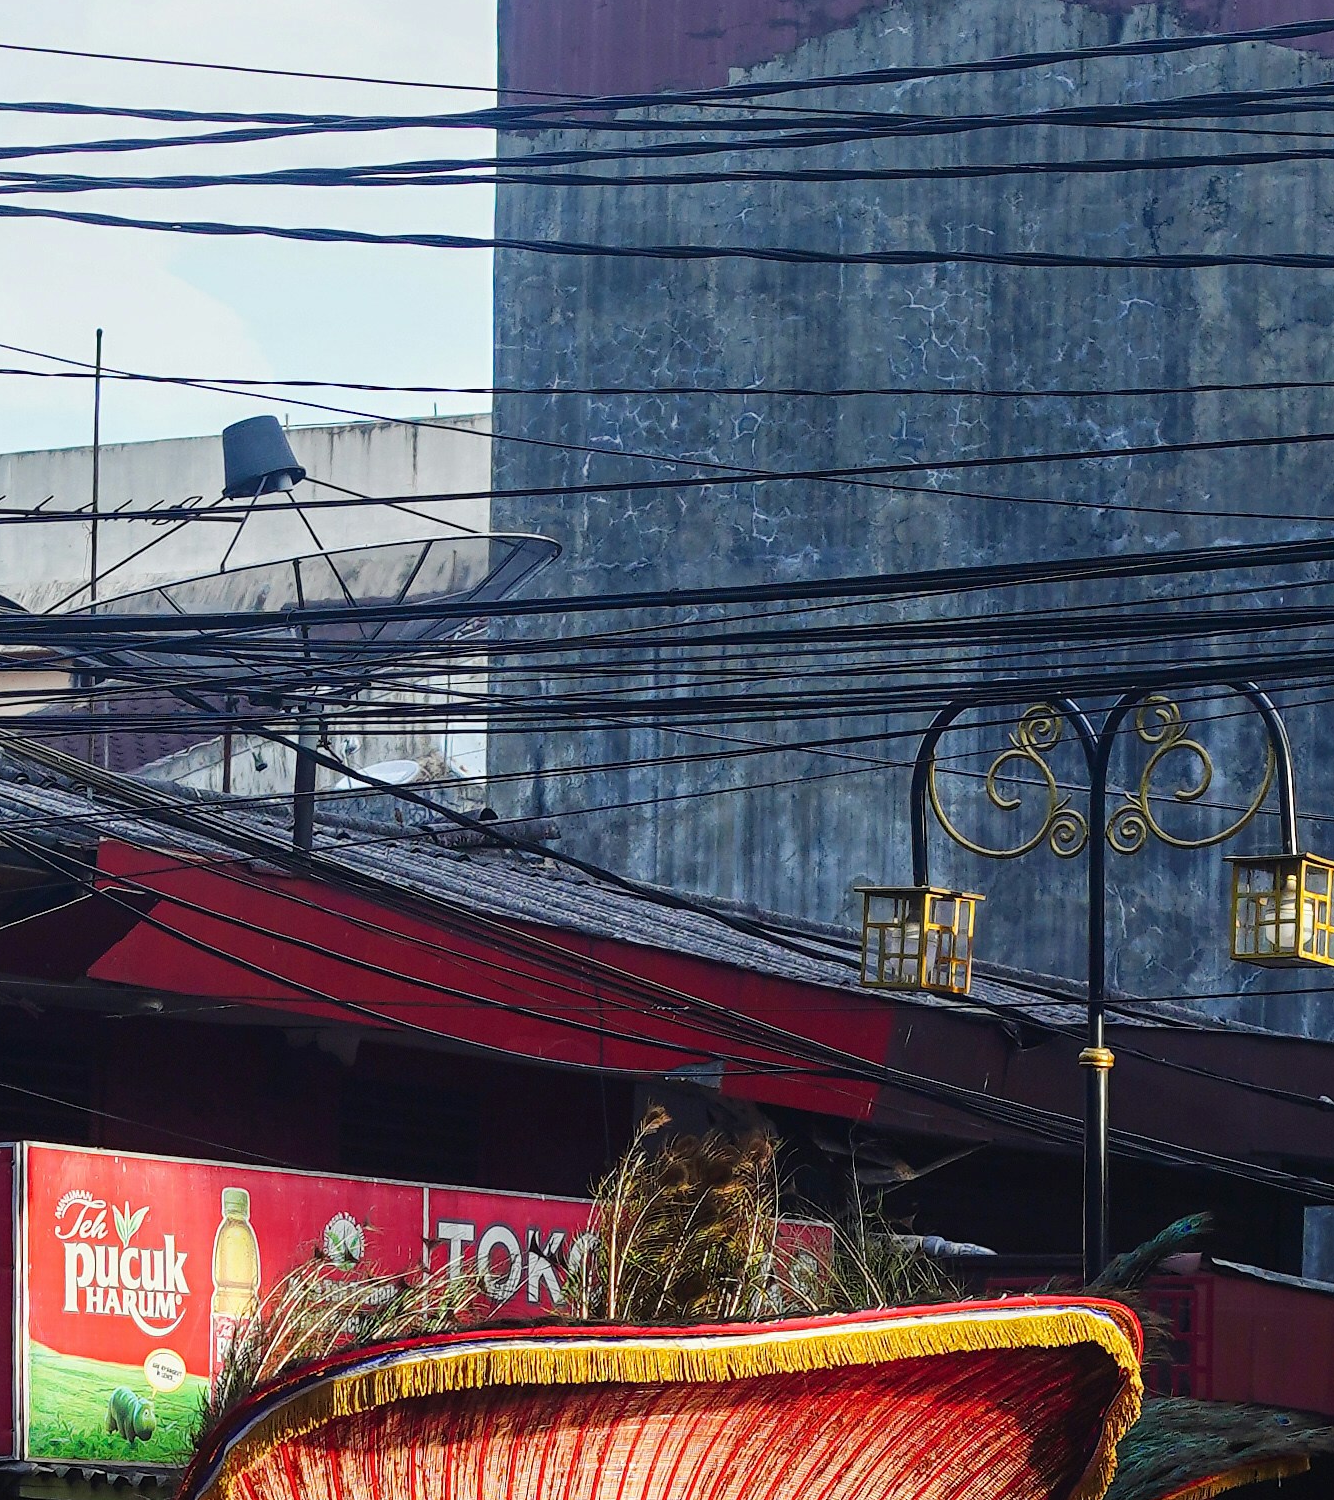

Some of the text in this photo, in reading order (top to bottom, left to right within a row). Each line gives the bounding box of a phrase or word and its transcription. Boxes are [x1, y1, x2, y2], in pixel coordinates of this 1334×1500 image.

[55, 1199, 109, 1240] Teh
[63, 1234, 191, 1313] pucuk
[86, 1287, 187, 1337] HARUM
